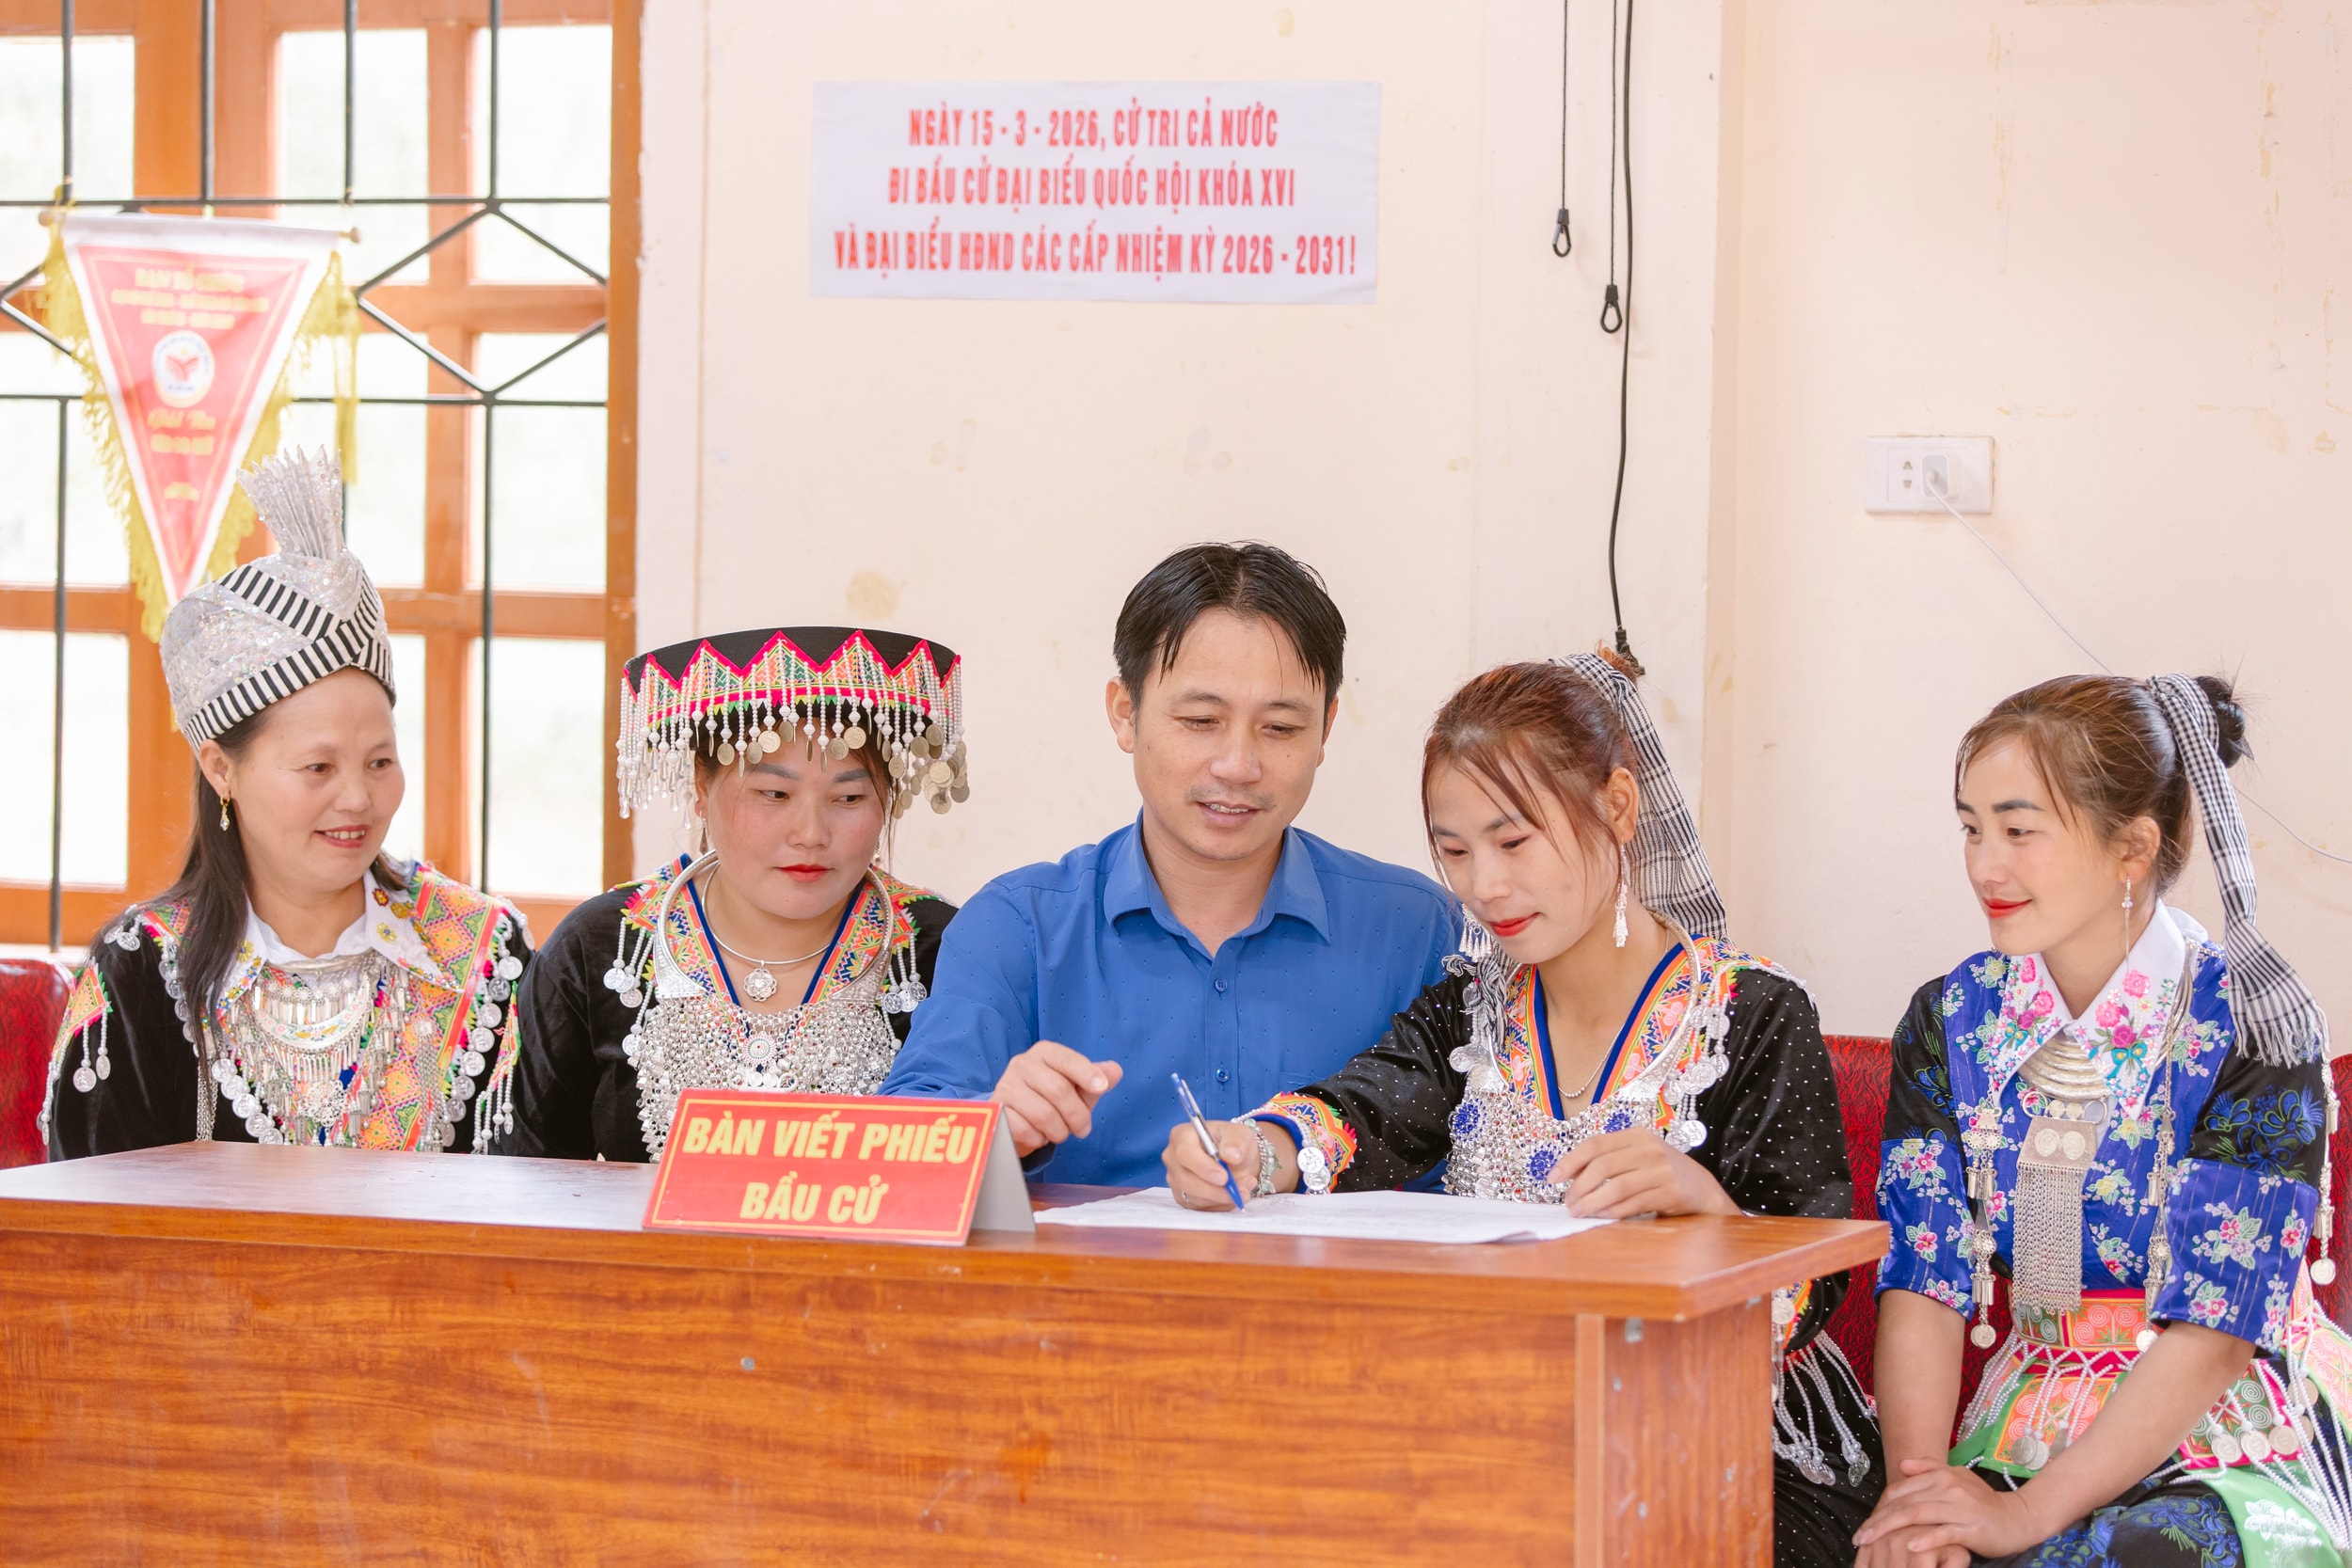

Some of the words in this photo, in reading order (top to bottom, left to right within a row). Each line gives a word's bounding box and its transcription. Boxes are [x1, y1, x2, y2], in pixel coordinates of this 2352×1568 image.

[909, 103, 962, 146] NGÀY
[971, 110, 993, 146] 15
[1015, 110, 1026, 146] 3
[1048, 110, 1105, 150] 2026,
[1114, 97, 1140, 146] CỬ
[1147, 109, 1179, 146] TRI
[1187, 97, 1213, 146] CẢ
[1220, 102, 1278, 146] NƯỚC
[889, 167, 909, 203] ĐI
[963, 155, 992, 204] CỬ
[996, 167, 1031, 214] ĐẠI
[1039, 153, 1086, 205] BIỂU
[1094, 156, 1148, 209] QUỐC
[1155, 161, 1190, 214] HỘI
[1199, 161, 1253, 206] KHÓA
[1261, 168, 1294, 206] XVI
[834, 223, 859, 269] VÀ
[866, 231, 898, 278] ĐẠI
[906, 216, 952, 270] BIỂU
[959, 232, 1014, 271] HĐND
[1022, 226, 1061, 272] CÁC
[1069, 220, 1108, 272] CẤP
[1116, 226, 1183, 281] NHIỆM
[1190, 227, 1216, 273] KỲ
[1222, 234, 1273, 274] 2026
[682, 1111, 766, 1155] BÀN
[774, 1111, 855, 1159] VIẾT
[859, 1115, 977, 1164] PHIẾU
[740, 1171, 821, 1222] BẦU
[828, 1175, 889, 1224] CỬ
